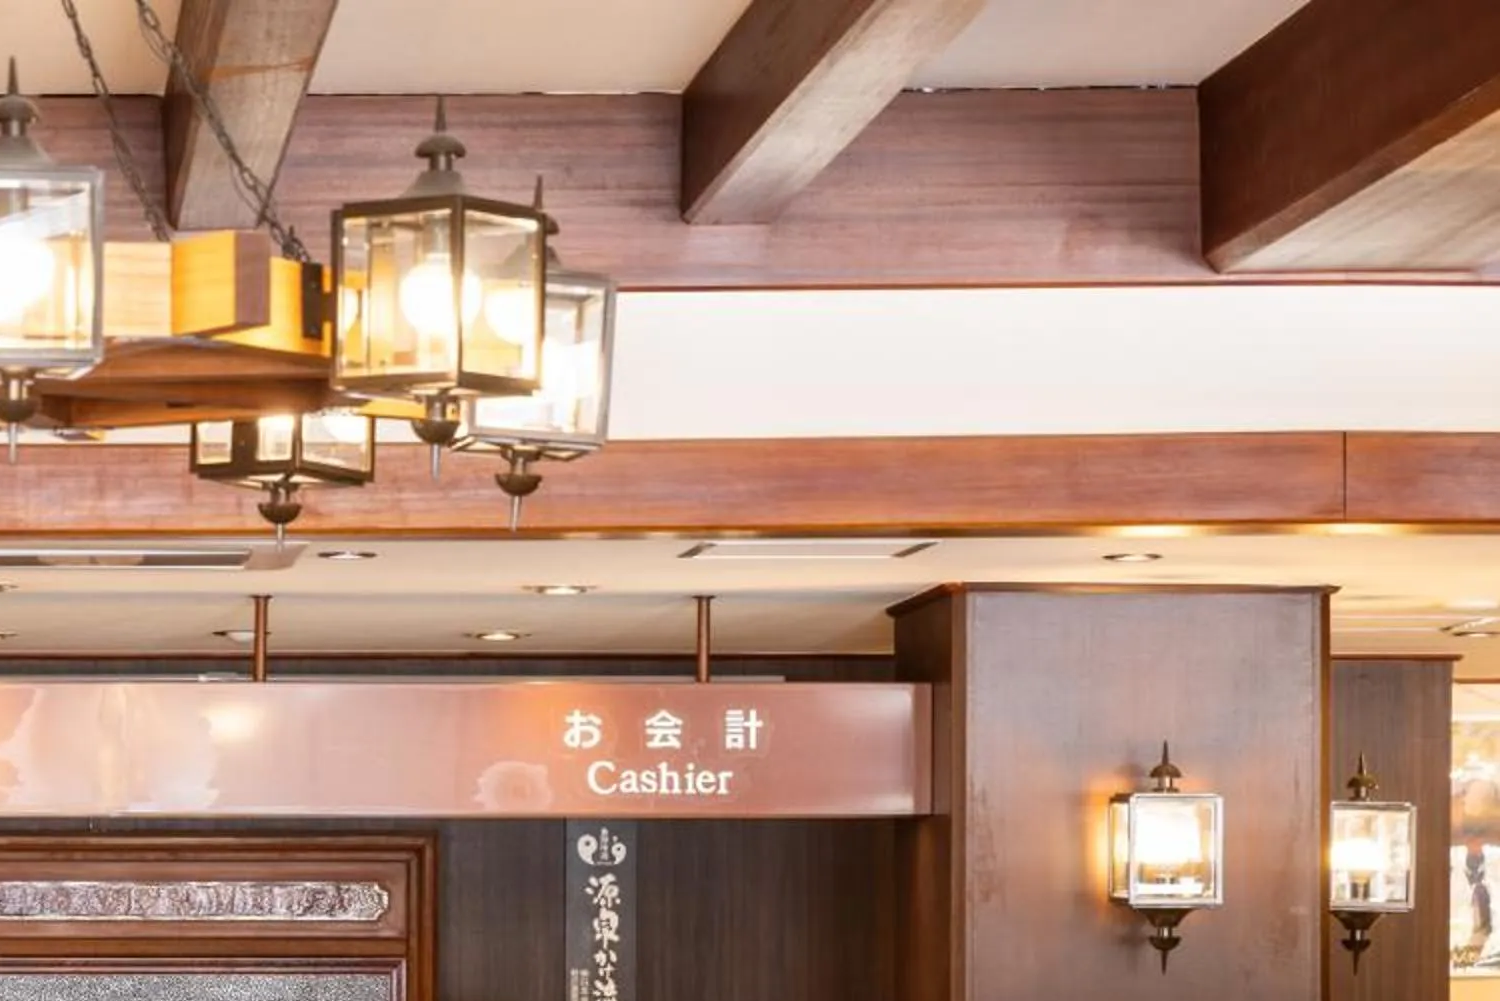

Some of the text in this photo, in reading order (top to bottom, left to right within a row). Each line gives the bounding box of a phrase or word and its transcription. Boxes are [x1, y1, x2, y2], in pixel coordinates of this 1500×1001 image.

[563, 709, 764, 750] お会計
[586, 760, 734, 795] Cashier
